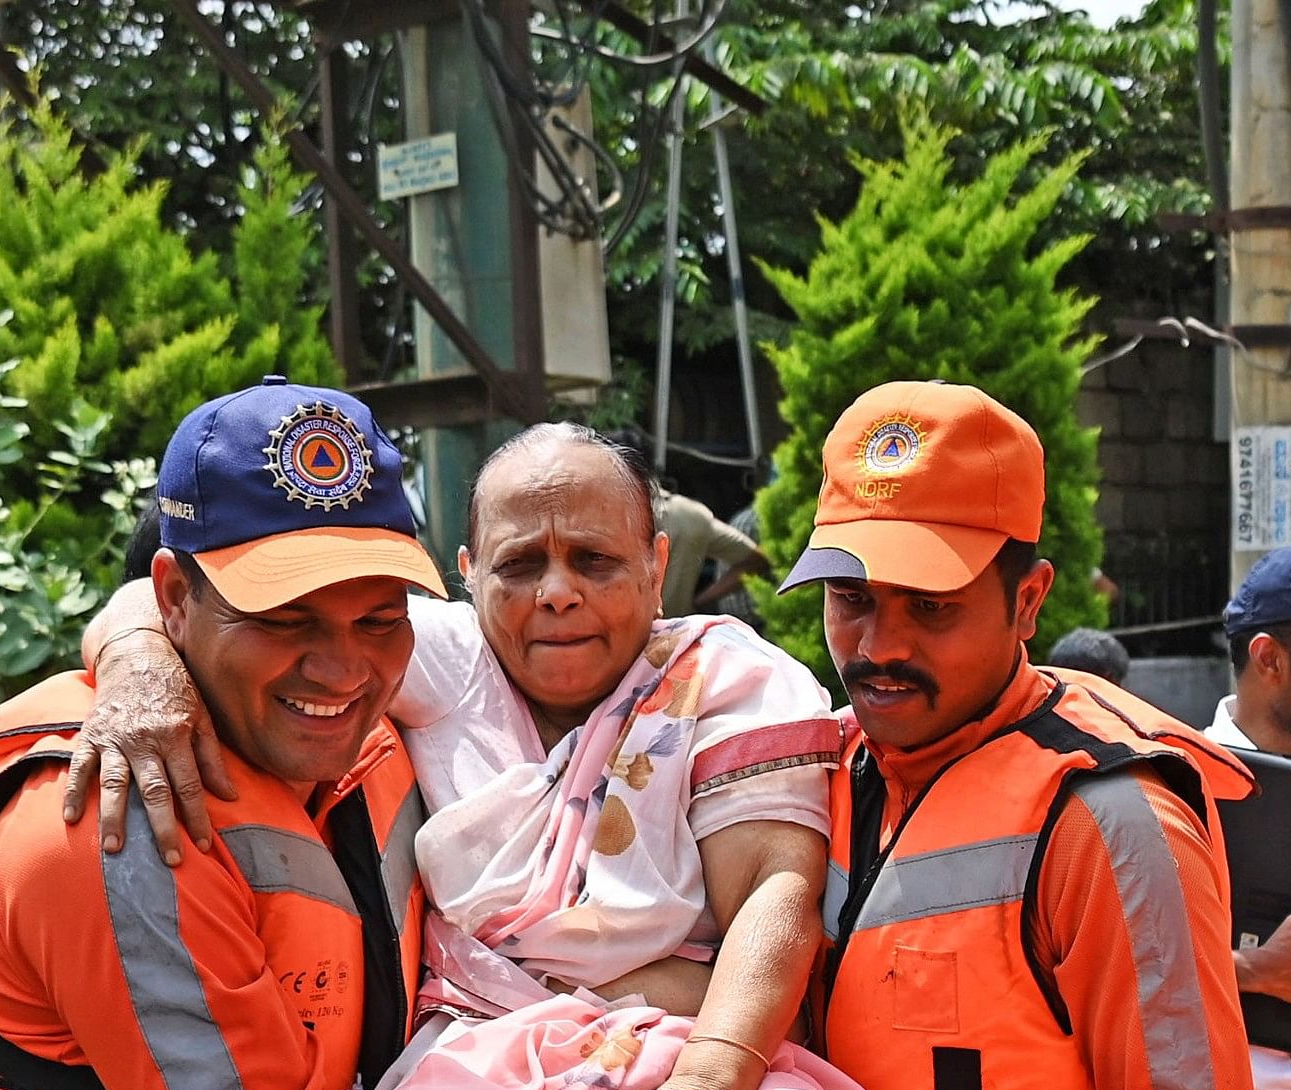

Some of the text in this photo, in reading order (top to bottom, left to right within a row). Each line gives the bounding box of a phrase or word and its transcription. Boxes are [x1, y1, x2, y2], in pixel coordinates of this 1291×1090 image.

[291, 420, 322, 440] DISASTER
[323, 420, 355, 449] RESPONSE
[855, 481, 903, 499] NDRF
